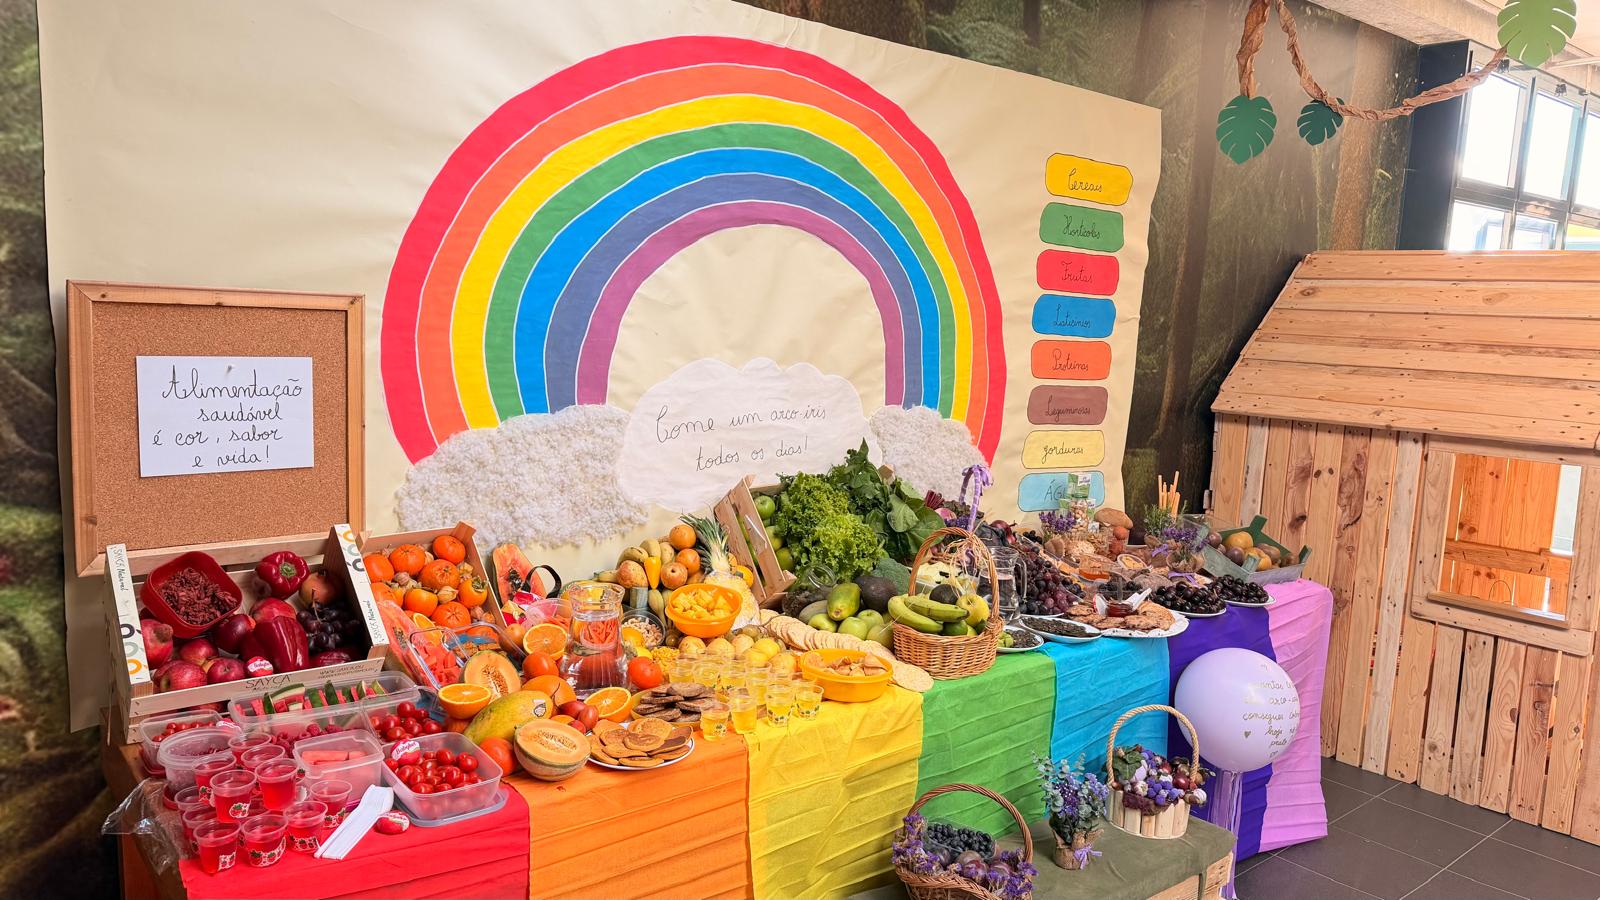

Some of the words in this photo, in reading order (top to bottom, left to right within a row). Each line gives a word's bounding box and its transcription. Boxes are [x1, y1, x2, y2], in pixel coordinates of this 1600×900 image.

[1068, 168, 1103, 193] Cereais
[1061, 261, 1092, 283] Frutas
[162, 364, 302, 400] Alimentação
[197, 402, 283, 422] saudável
[656, 405, 715, 443] Come
[729, 412, 763, 427] um
[152, 429, 162, 446] é
[228, 424, 284, 441] sabor
[191, 455, 203, 468] e
[217, 444, 269, 467] vida!
[696, 444, 740, 472] todos
[751, 448, 763, 460] os
[776, 435, 808, 457] dias!
[246, 674, 291, 690] SAYCA
